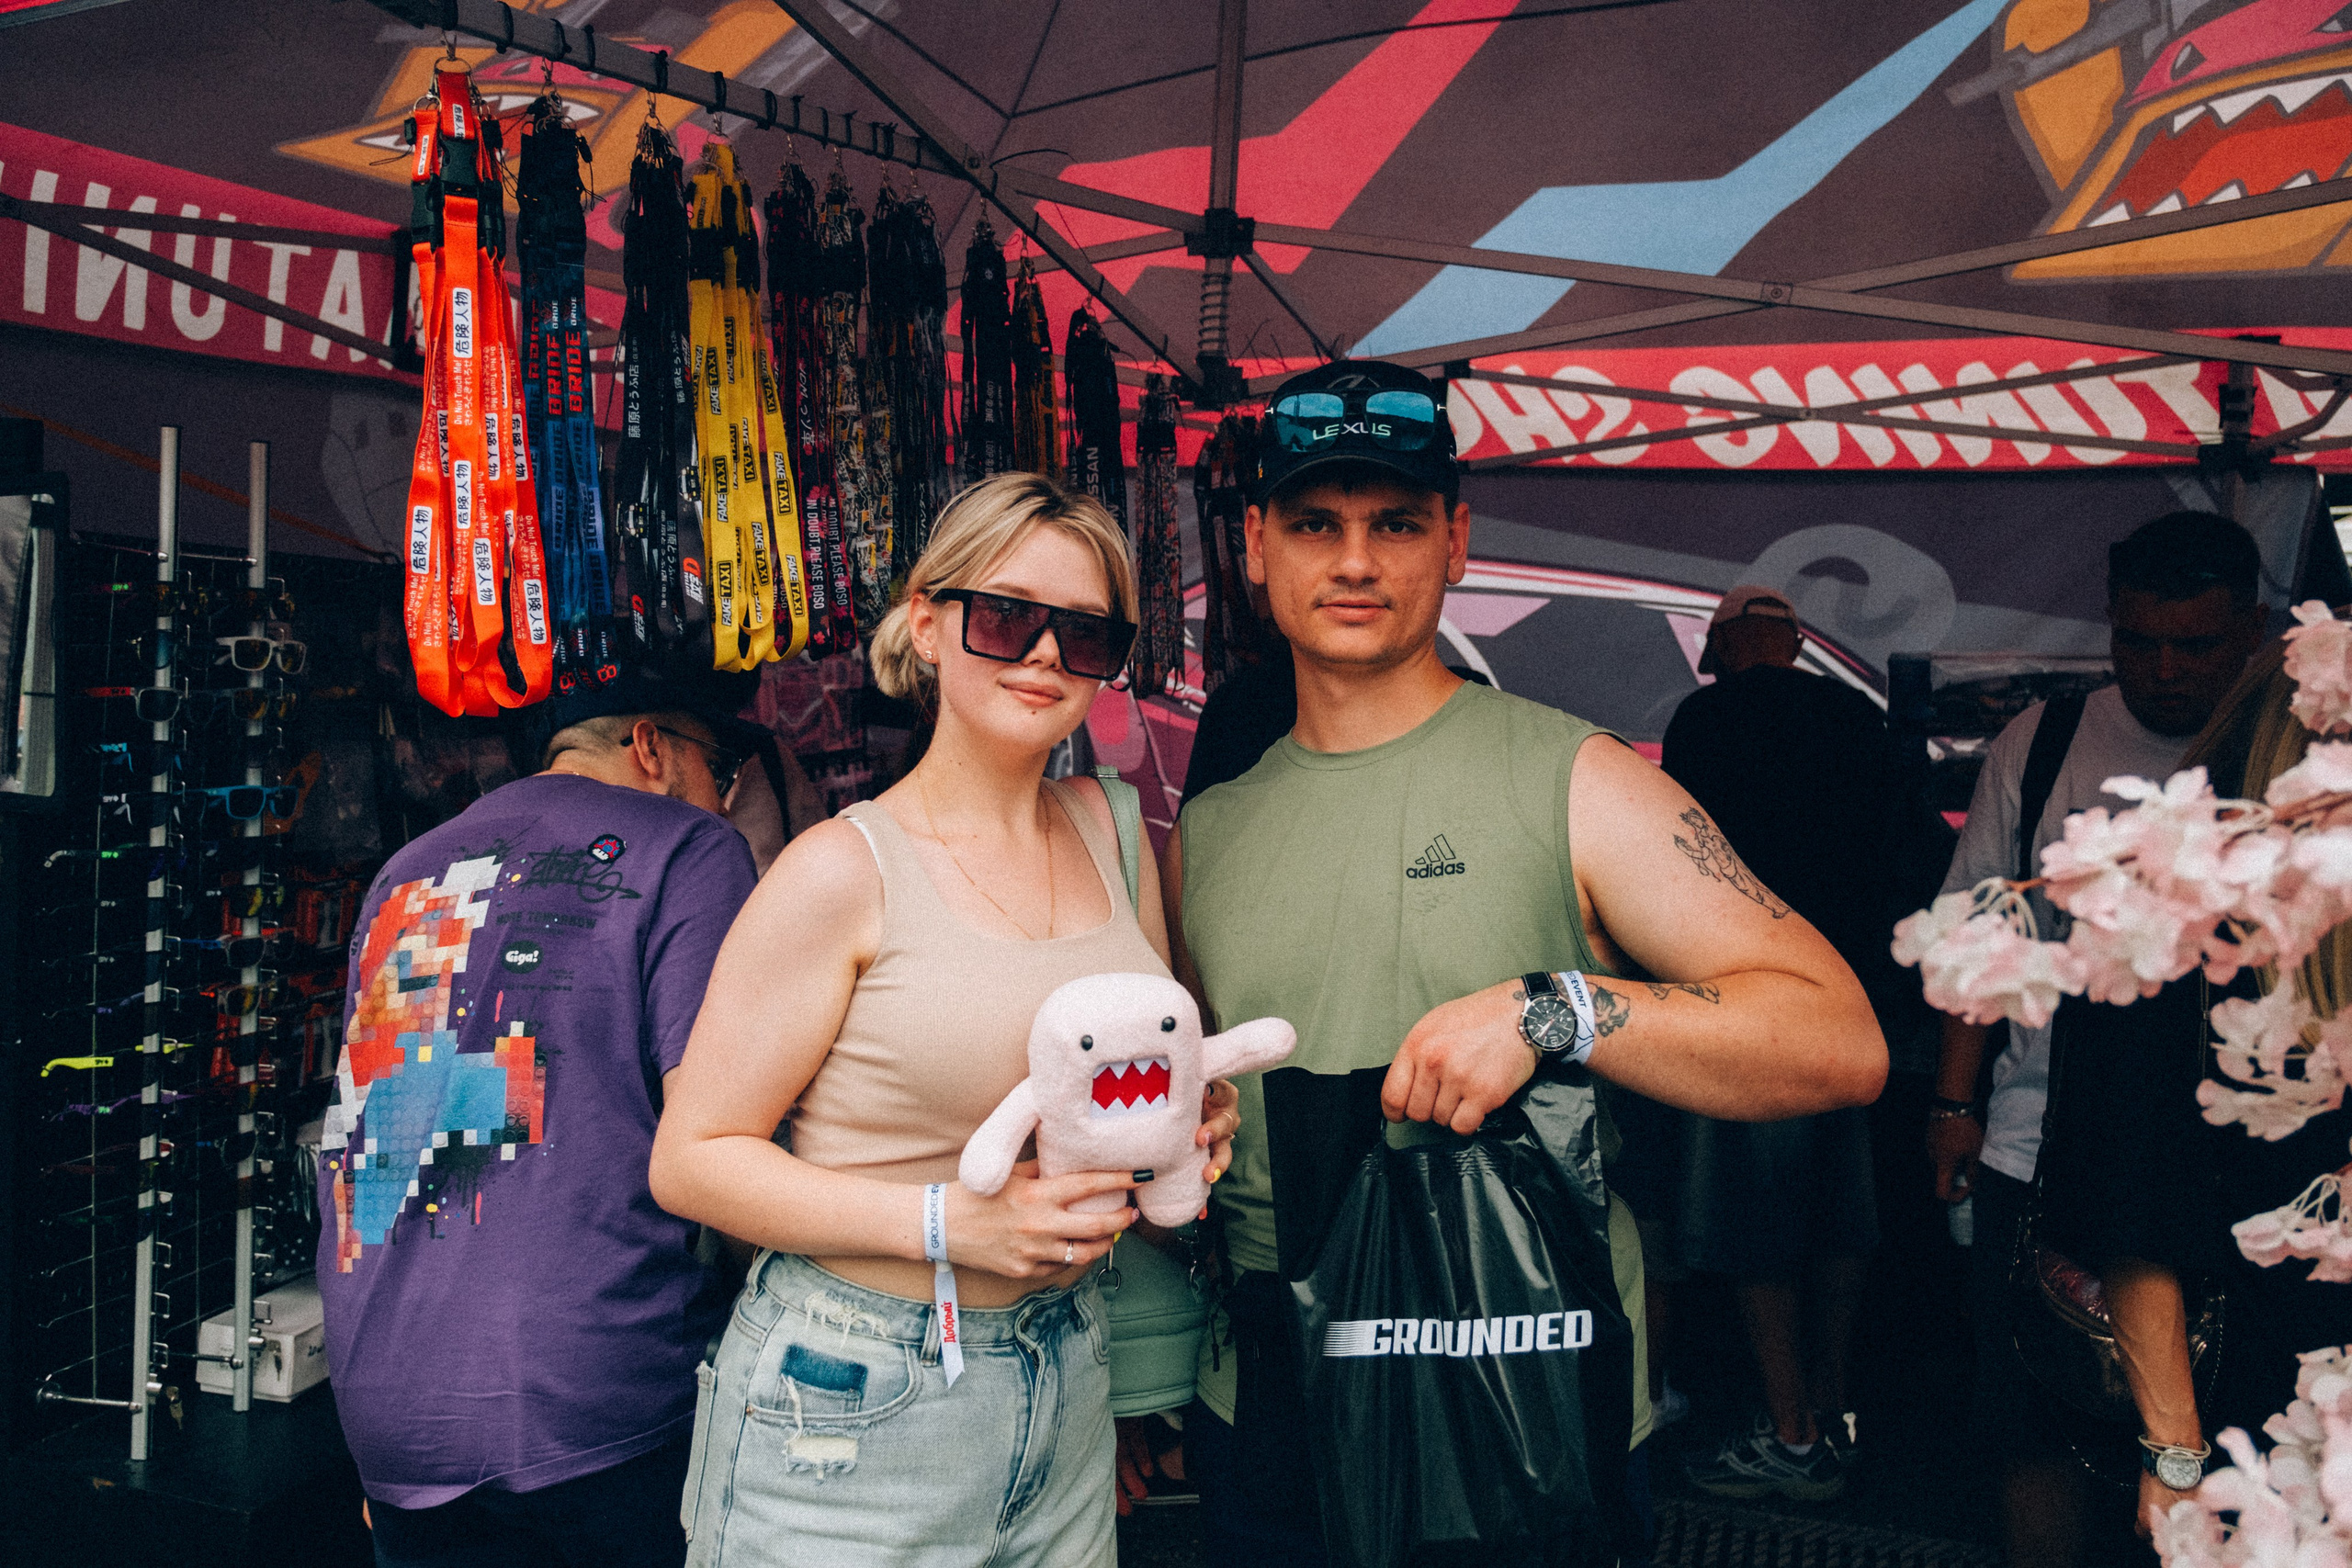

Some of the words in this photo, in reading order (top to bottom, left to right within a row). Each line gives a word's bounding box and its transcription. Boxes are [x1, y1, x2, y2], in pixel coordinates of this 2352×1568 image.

[454, 290, 470, 355] 危険人物
[453, 359, 462, 373] Me!
[566, 331, 582, 412] BRIDE
[708, 348, 719, 386] TAXI
[453, 376, 463, 399] Touch
[709, 386, 721, 415] FAKE
[453, 400, 462, 413] Not
[453, 415, 462, 425] Do
[1313, 422, 1392, 440] LEXUS
[715, 457, 728, 494] TAXI
[774, 452, 786, 479] FAKE
[457, 464, 469, 525] 危険人物
[718, 493, 729, 523] FAKE
[777, 479, 791, 514] TAXI
[526, 514, 534, 525] Do
[527, 526, 536, 540] Not
[413, 509, 430, 571] 危険人物
[751, 522, 763, 551] FAKE
[529, 541, 539, 562] Touch
[475, 540, 494, 603] 危険人物
[531, 564, 541, 577] Me!
[718, 562, 732, 598] TAXI
[755, 550, 768, 584] TAXI
[786, 554, 798, 582] FAKE
[790, 581, 804, 616] TAXI
[812, 584, 825, 609] BOSO
[834, 581, 848, 606] BOSO
[526, 581, 545, 641] 危険人物
[722, 597, 732, 626] FAKE
[1405, 862, 1465, 879] adidas
[504, 949, 540, 966] Giga!
[942, 1301, 956, 1343] Добрый
[1365, 1309, 1593, 1358] GROUNDED
